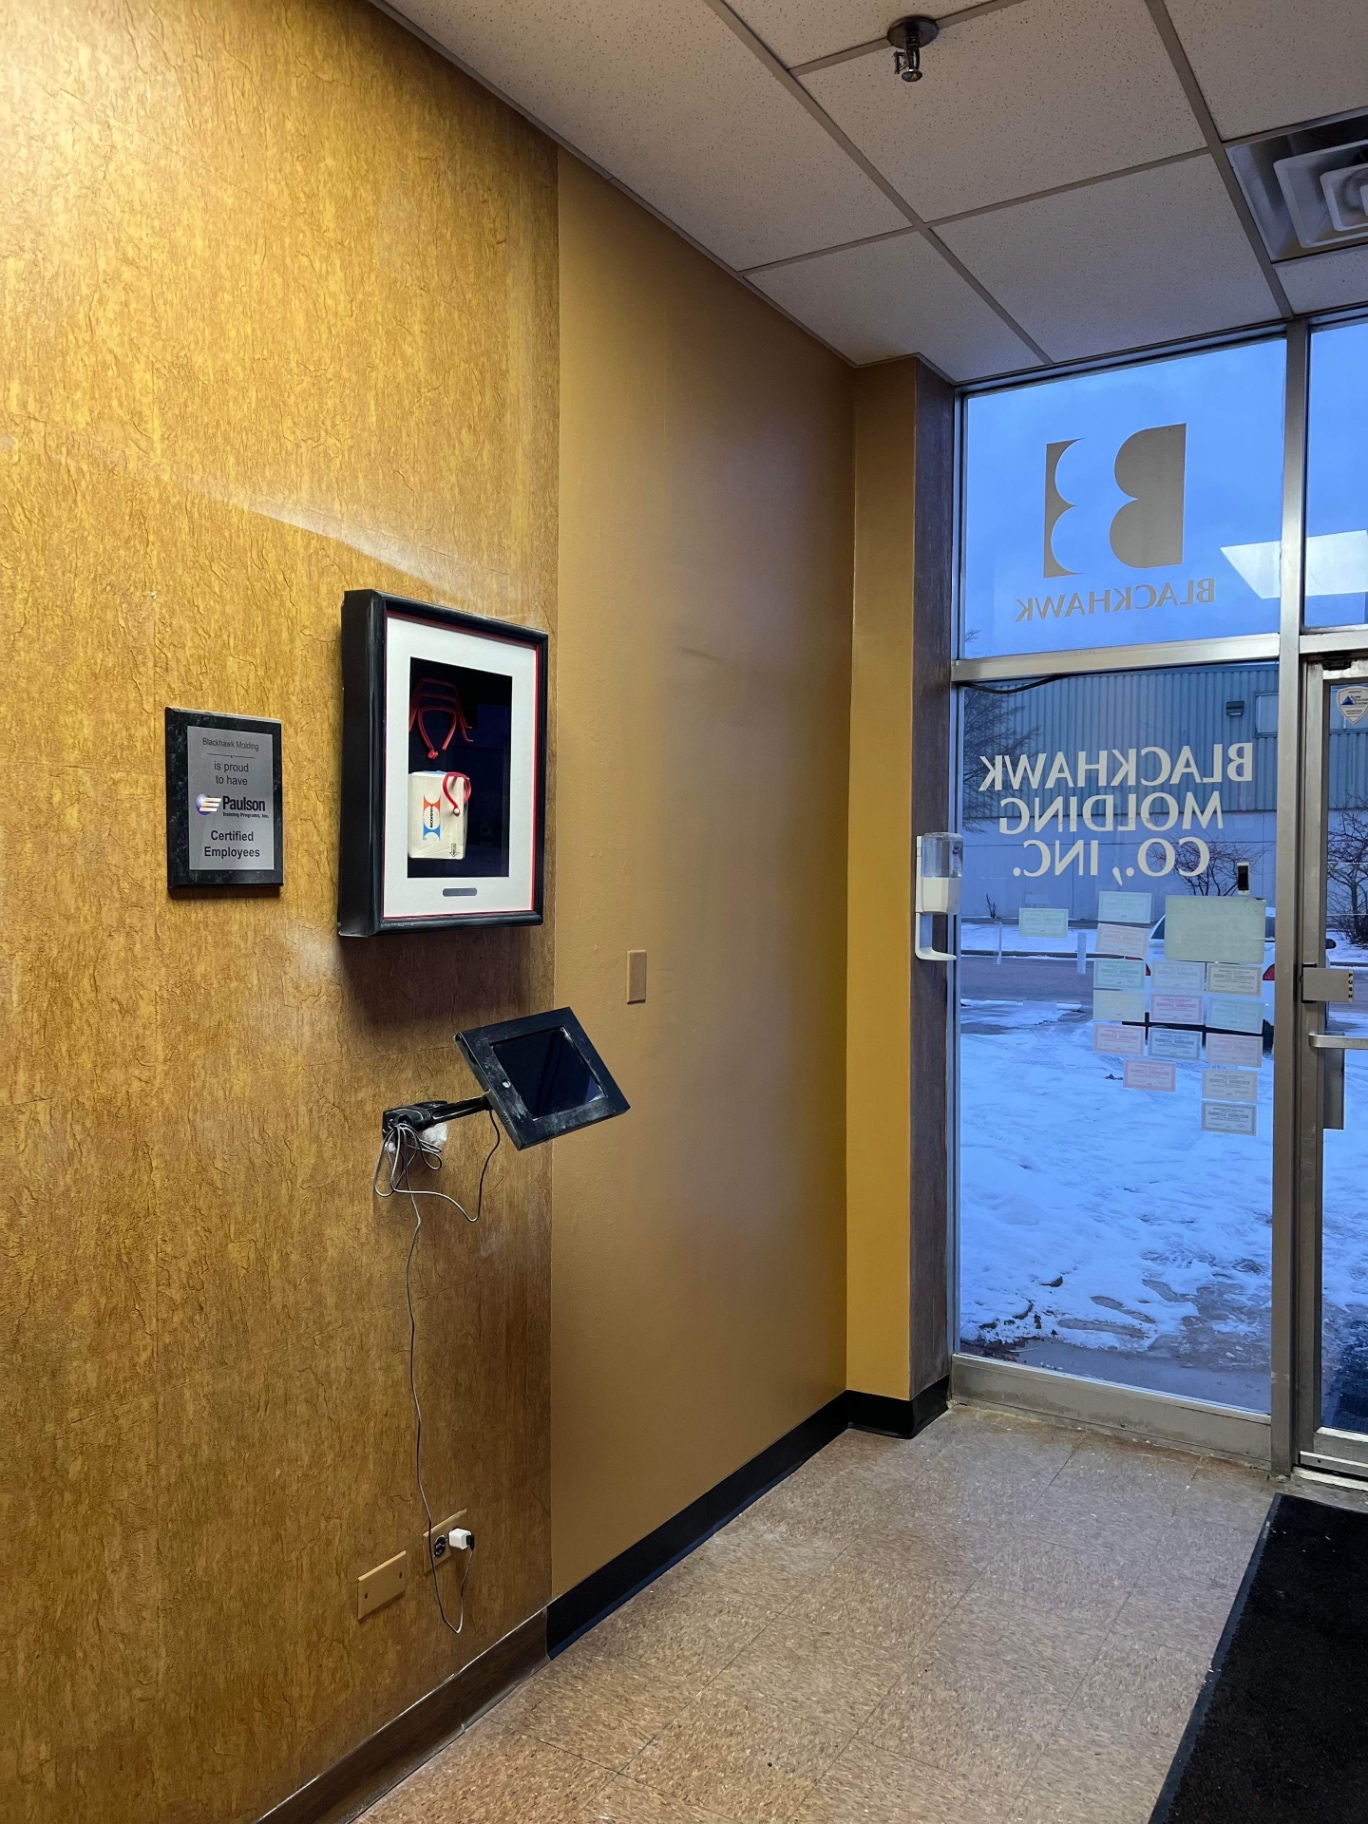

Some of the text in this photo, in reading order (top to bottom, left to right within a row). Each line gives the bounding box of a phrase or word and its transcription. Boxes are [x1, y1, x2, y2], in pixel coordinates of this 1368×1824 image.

[202, 737, 259, 752] Blackhawk Molding
[214, 761, 249, 773] is proud
[215, 775, 248, 786] to have
[222, 795, 266, 812] Paulson
[210, 829, 254, 842] Certified
[204, 846, 261, 860] Employees
